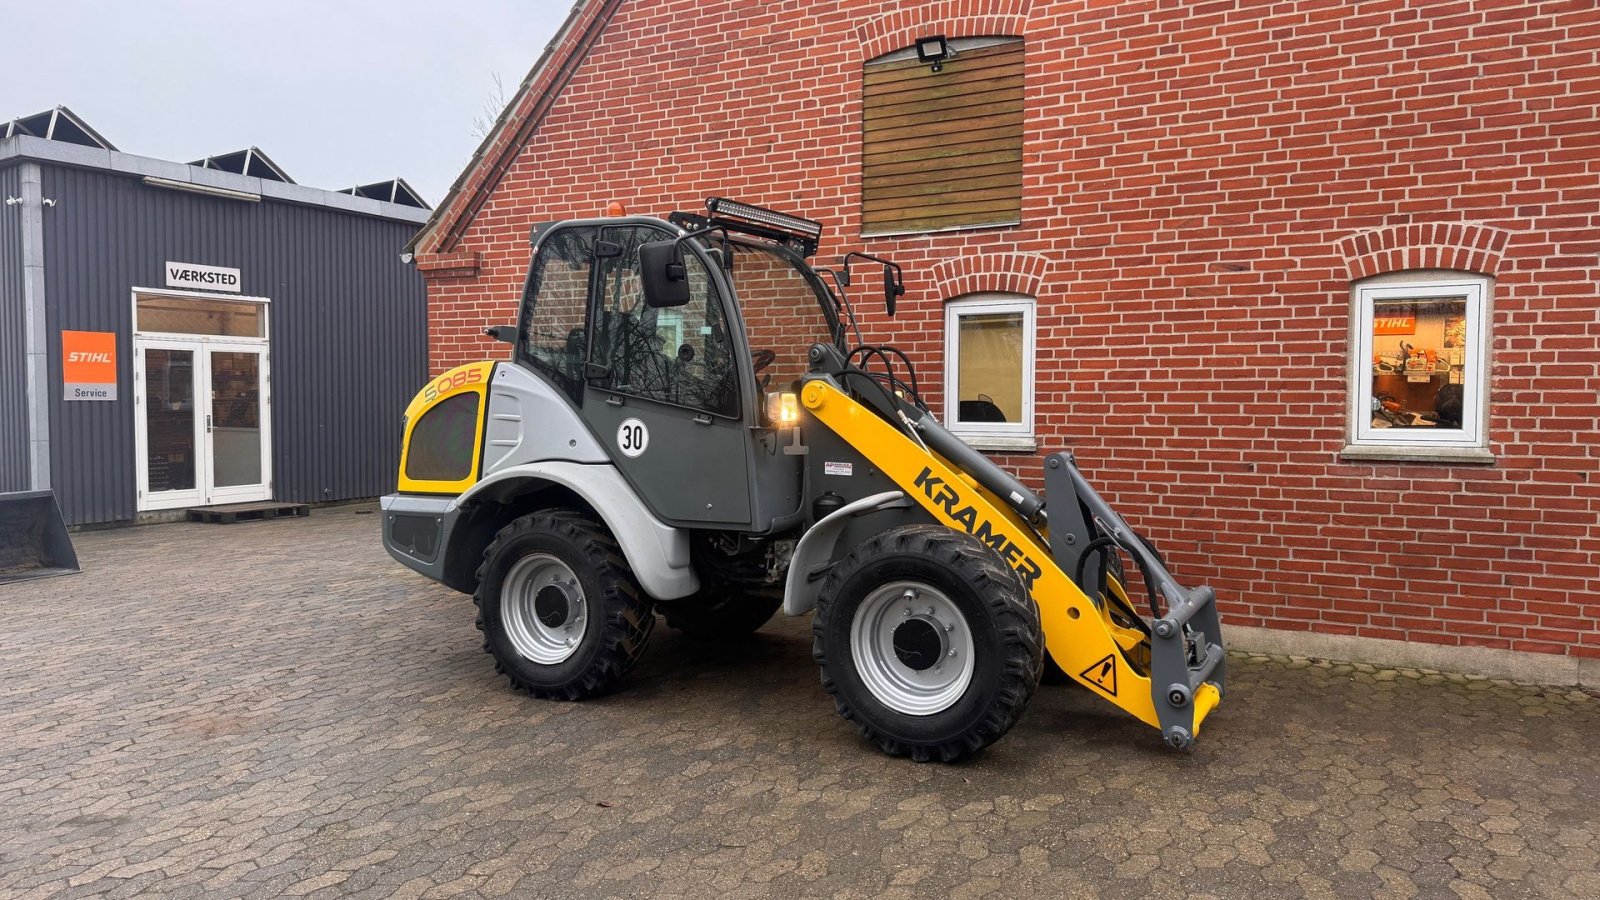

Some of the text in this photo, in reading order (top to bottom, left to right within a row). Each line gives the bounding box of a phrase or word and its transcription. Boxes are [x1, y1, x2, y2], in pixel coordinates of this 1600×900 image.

[170, 268, 237, 285] VÆRKSTED
[67, 352, 112, 363] STIHL
[74, 387, 107, 397] Service
[424, 368, 482, 403] 5085
[622, 425, 643, 450] 30
[913, 466, 1042, 592] KRAMER
